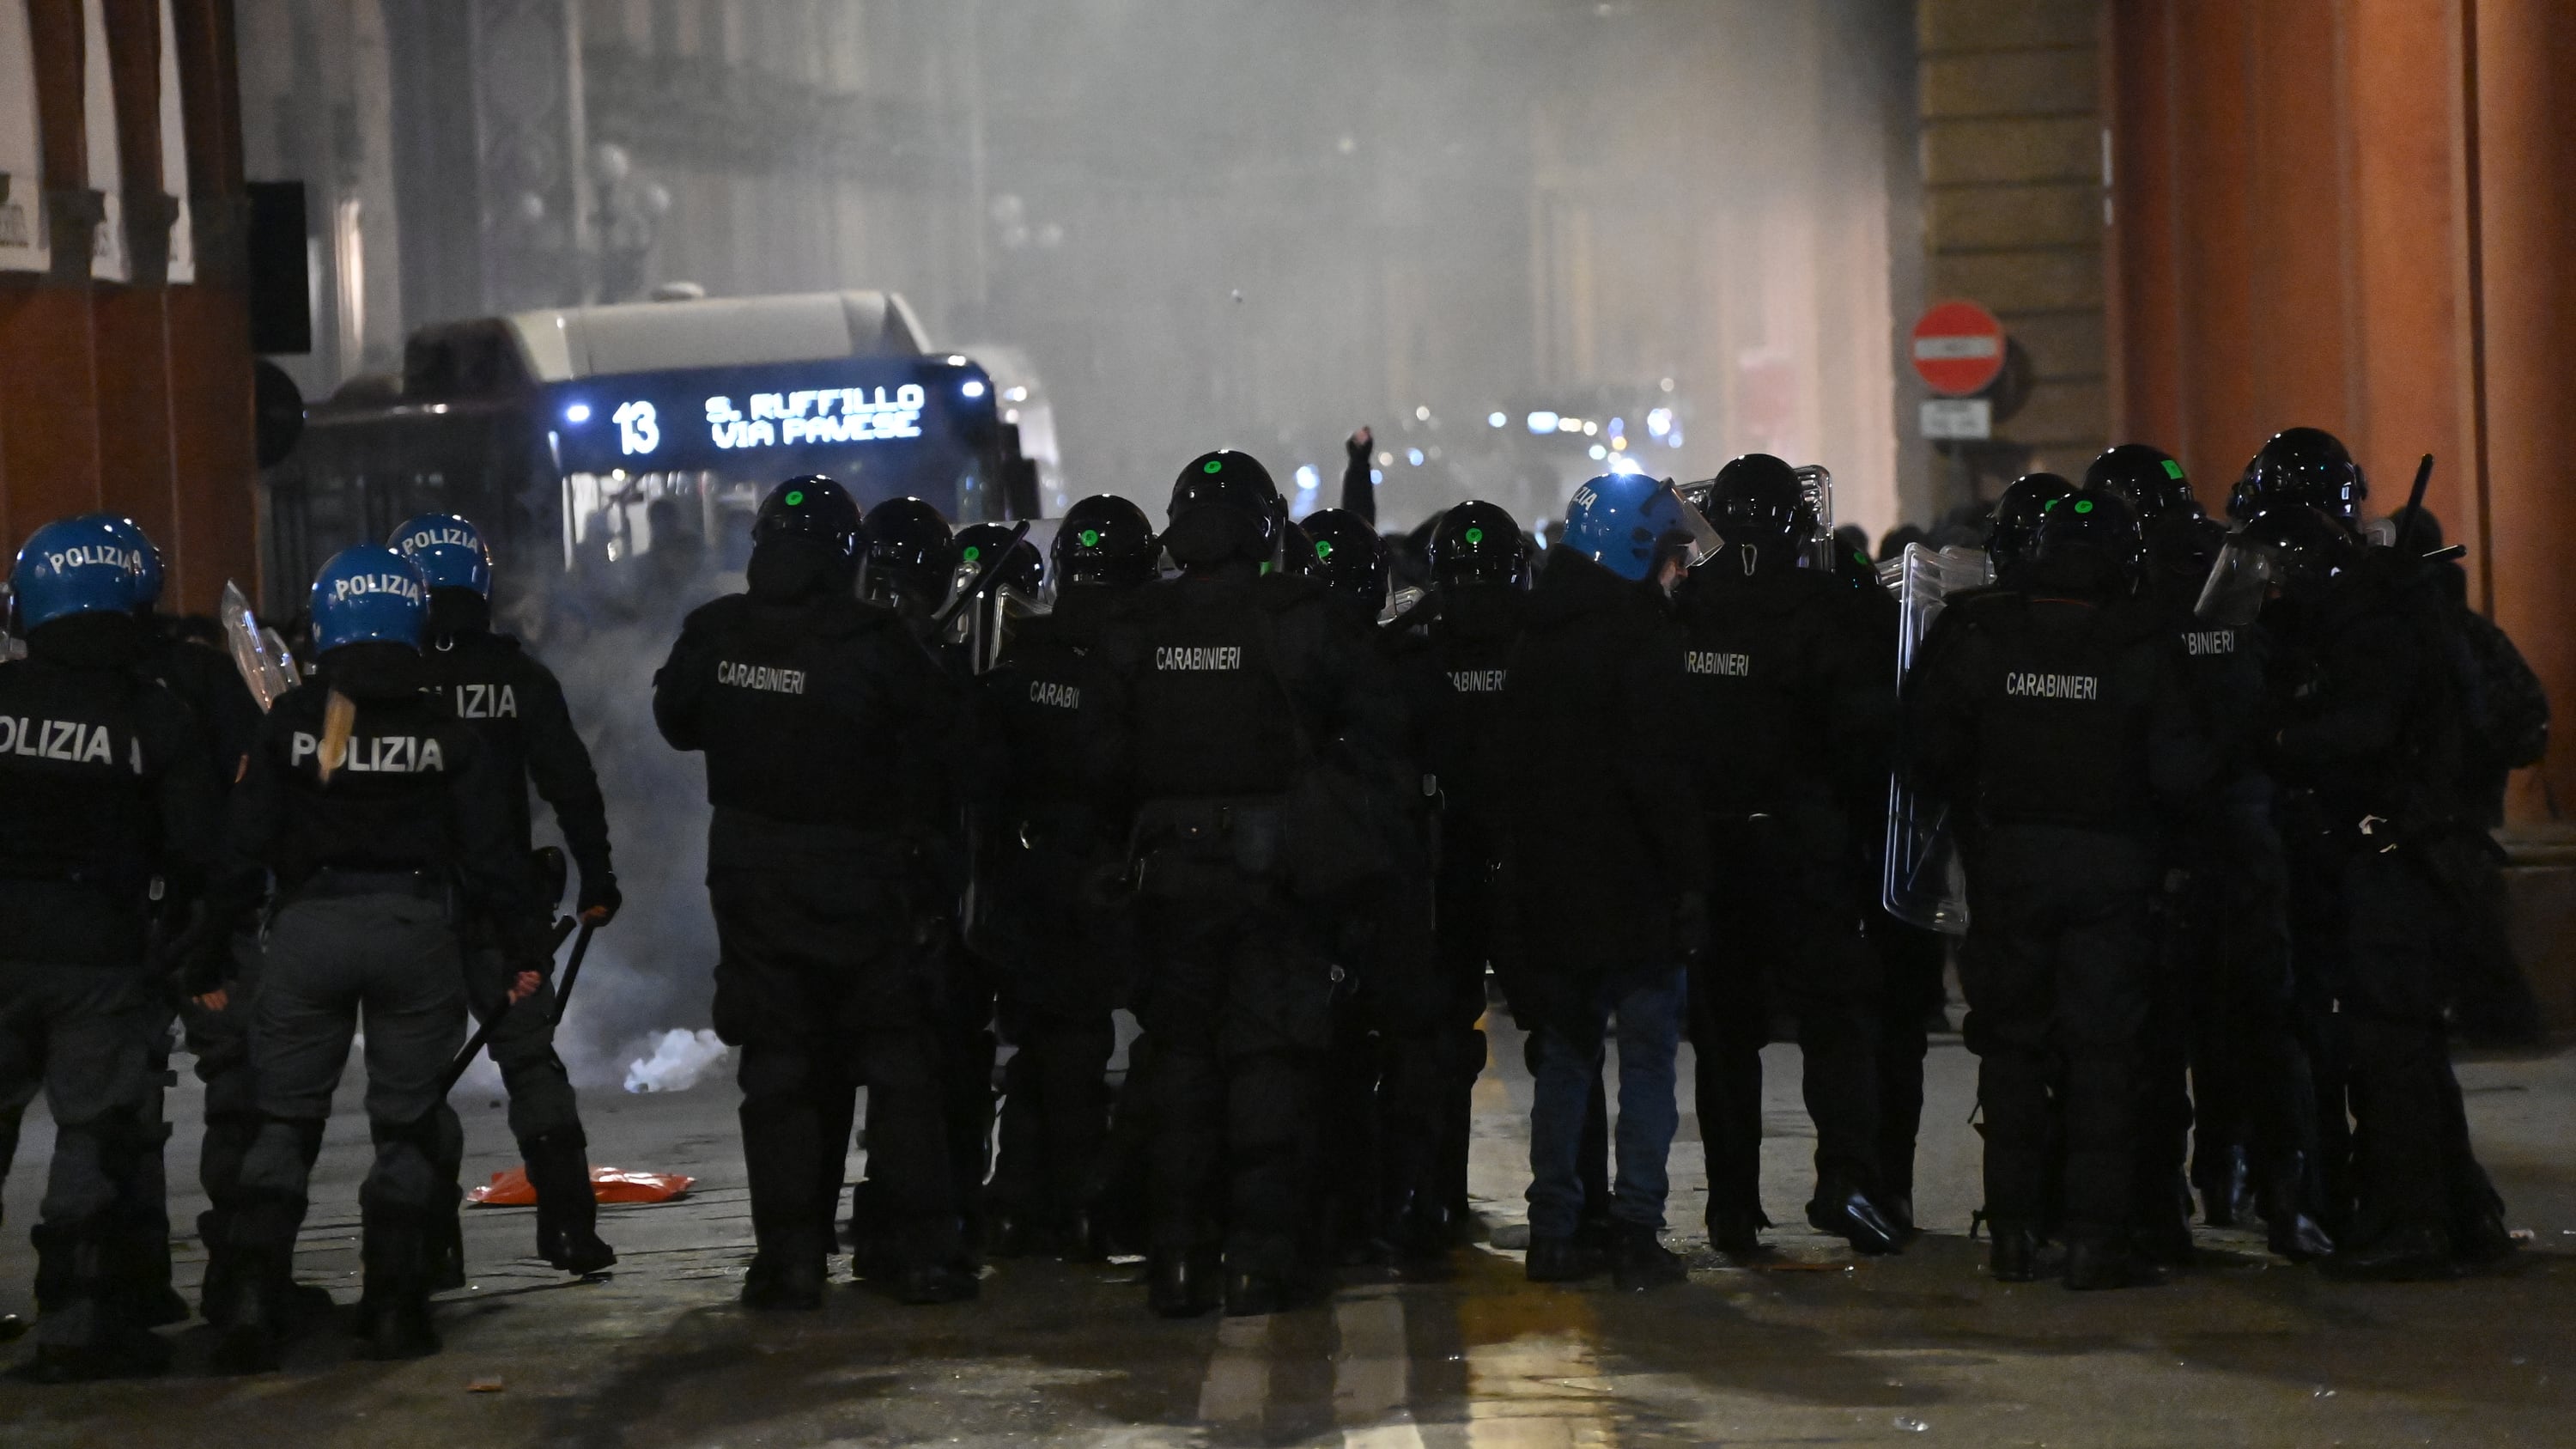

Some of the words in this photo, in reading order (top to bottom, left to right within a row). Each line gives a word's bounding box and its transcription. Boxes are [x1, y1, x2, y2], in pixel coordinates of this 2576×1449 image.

[706, 396, 741, 423] S.
[750, 384, 924, 420] RUFFILLO
[613, 401, 659, 455] 13
[712, 420, 775, 448] VIA
[782, 411, 921, 444] PAVESE
[404, 528, 477, 555] POLIZIA
[49, 545, 132, 575] POLIZIA
[336, 574, 418, 604] POLIZIA
[1156, 646, 1241, 670] CARABINIERI
[2181, 631, 2234, 655] BINIERI
[717, 660, 805, 695] CARABINIERI
[1446, 670, 1506, 692] ABINIER
[2007, 672, 2097, 700] CARABINIERI
[418, 684, 517, 718] IZIA
[0, 715, 112, 764] OLIZIA
